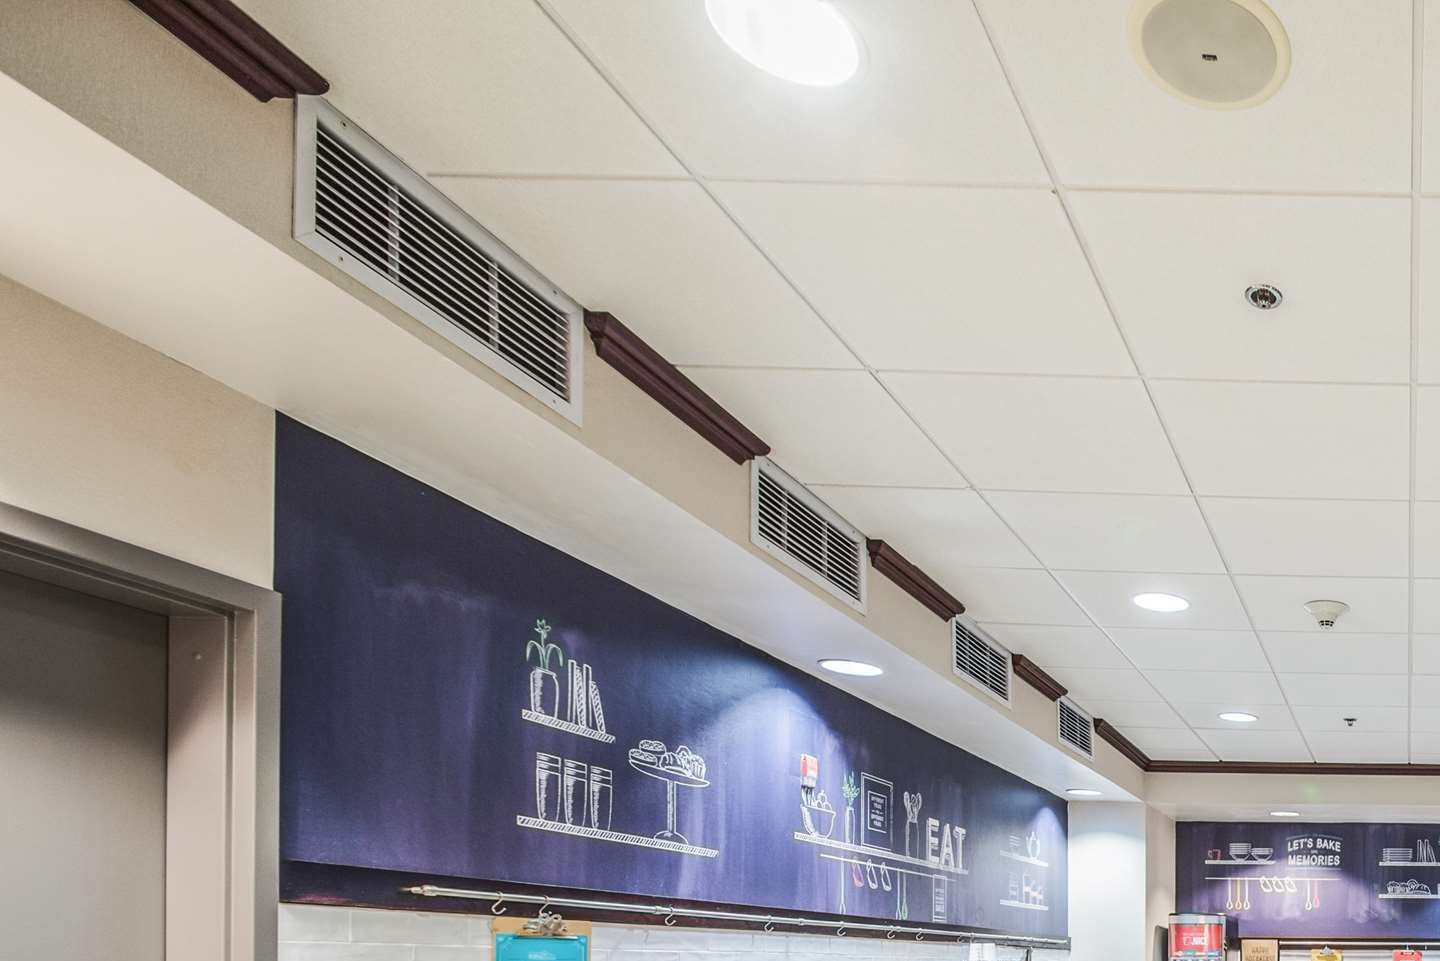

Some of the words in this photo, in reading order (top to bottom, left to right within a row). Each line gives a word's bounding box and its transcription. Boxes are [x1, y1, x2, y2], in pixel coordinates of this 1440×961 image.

[926, 817, 967, 869] EAT
[1288, 838, 1313, 852] LET'S
[1316, 838, 1341, 852] BAKE
[1288, 854, 1341, 866] MEMORIES
